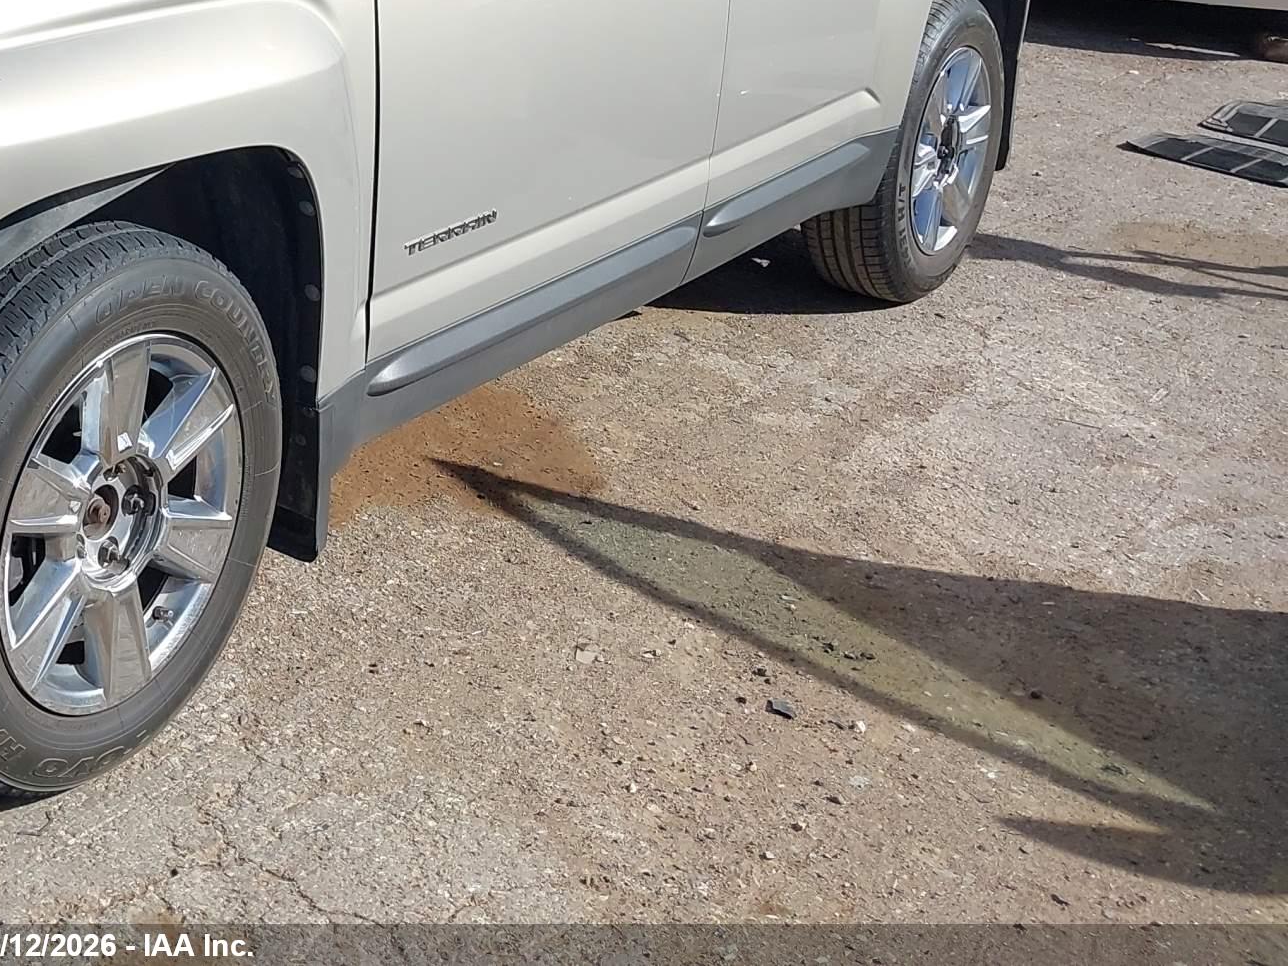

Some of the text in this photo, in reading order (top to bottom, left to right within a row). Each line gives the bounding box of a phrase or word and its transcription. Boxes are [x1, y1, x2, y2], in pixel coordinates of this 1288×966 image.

[403, 208, 498, 257] TERRAIN
[95, 274, 278, 404] OPEN COUNTRY
